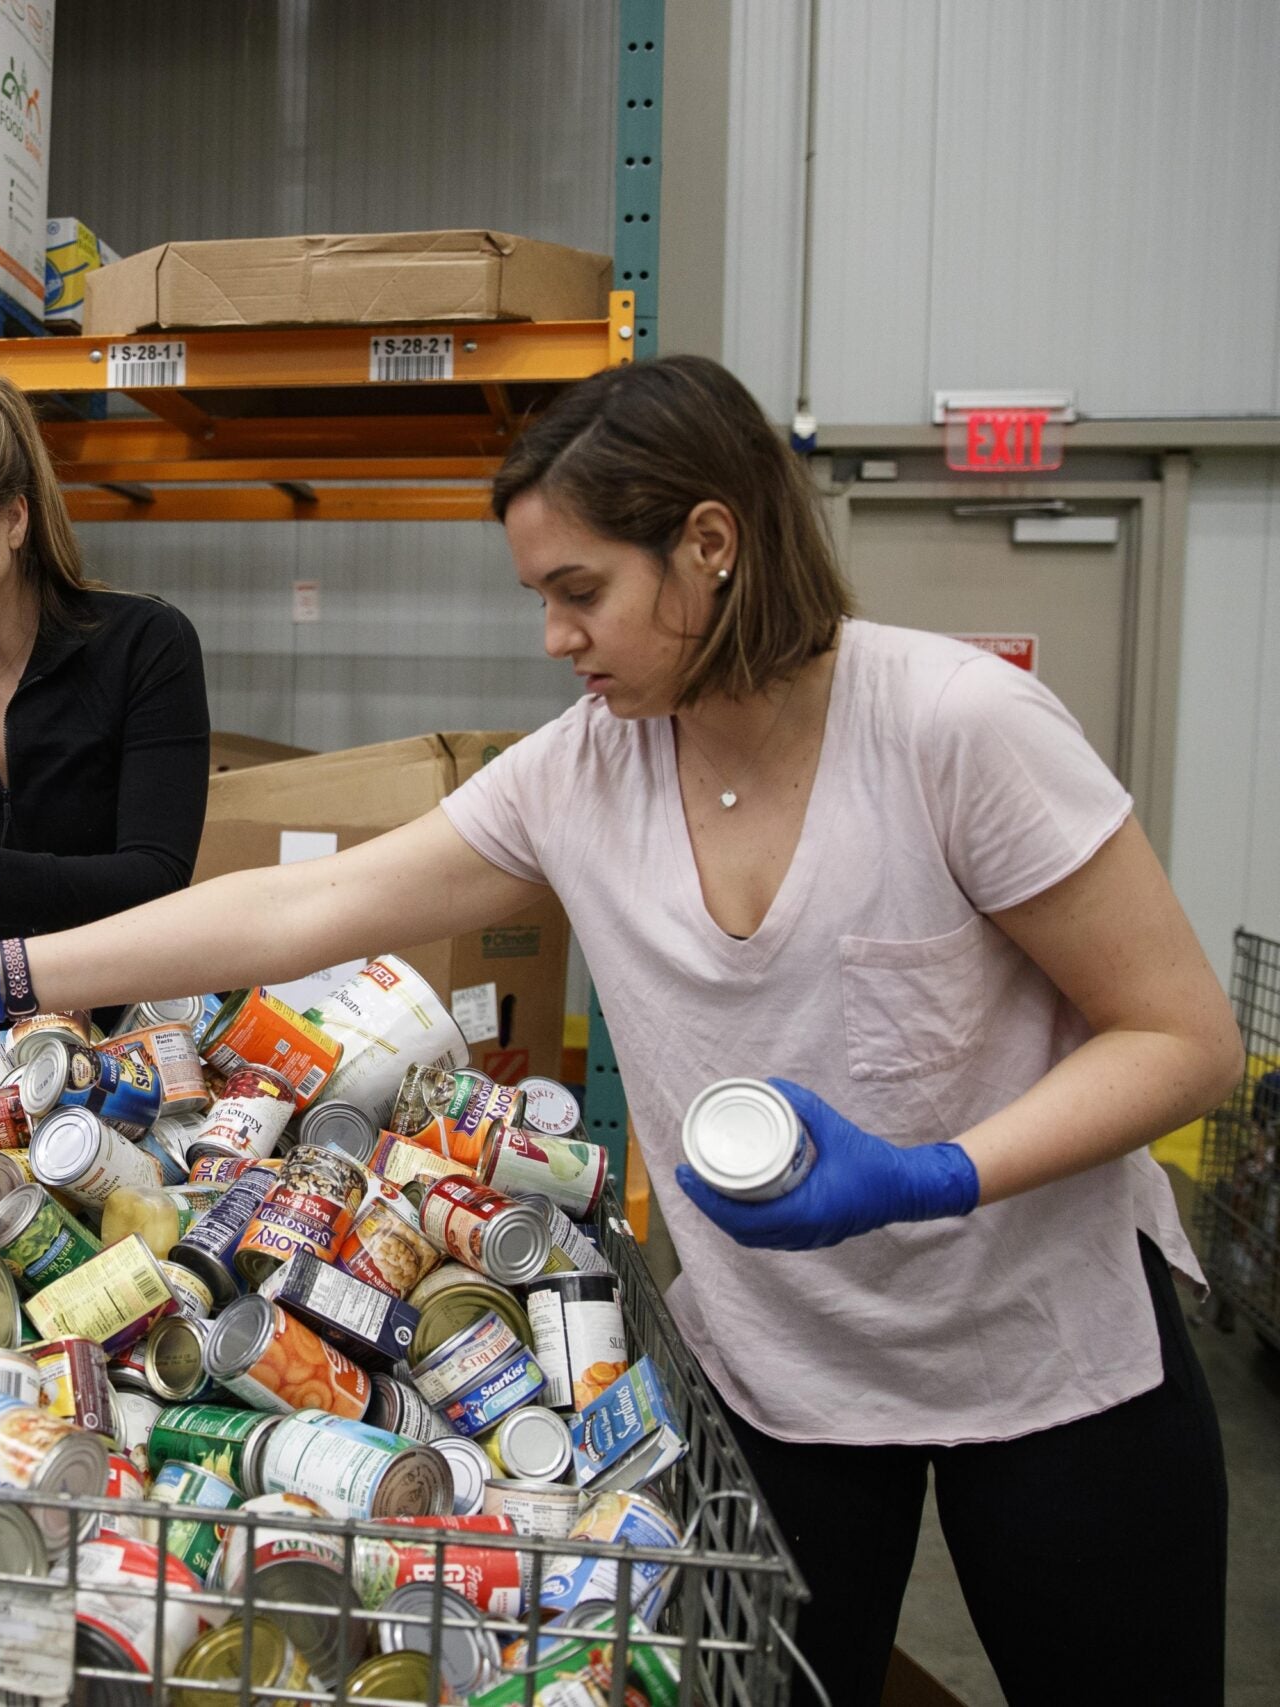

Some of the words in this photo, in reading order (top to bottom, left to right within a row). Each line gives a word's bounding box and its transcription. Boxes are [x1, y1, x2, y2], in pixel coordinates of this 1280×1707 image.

[121, 345, 171, 361] S-28-1
[385, 338, 439, 355] S-28-2
[967, 413, 1050, 466] EXIT
[336, 989, 363, 1018] Beans
[227, 1109, 263, 1134] Kidney
[260, 1206, 330, 1246] SEASONED
[303, 1201, 331, 1223] BLACK
[251, 1225, 317, 1256] GLORY
[480, 1363, 526, 1399] StarKist
[613, 1385, 641, 1439] Sardines
